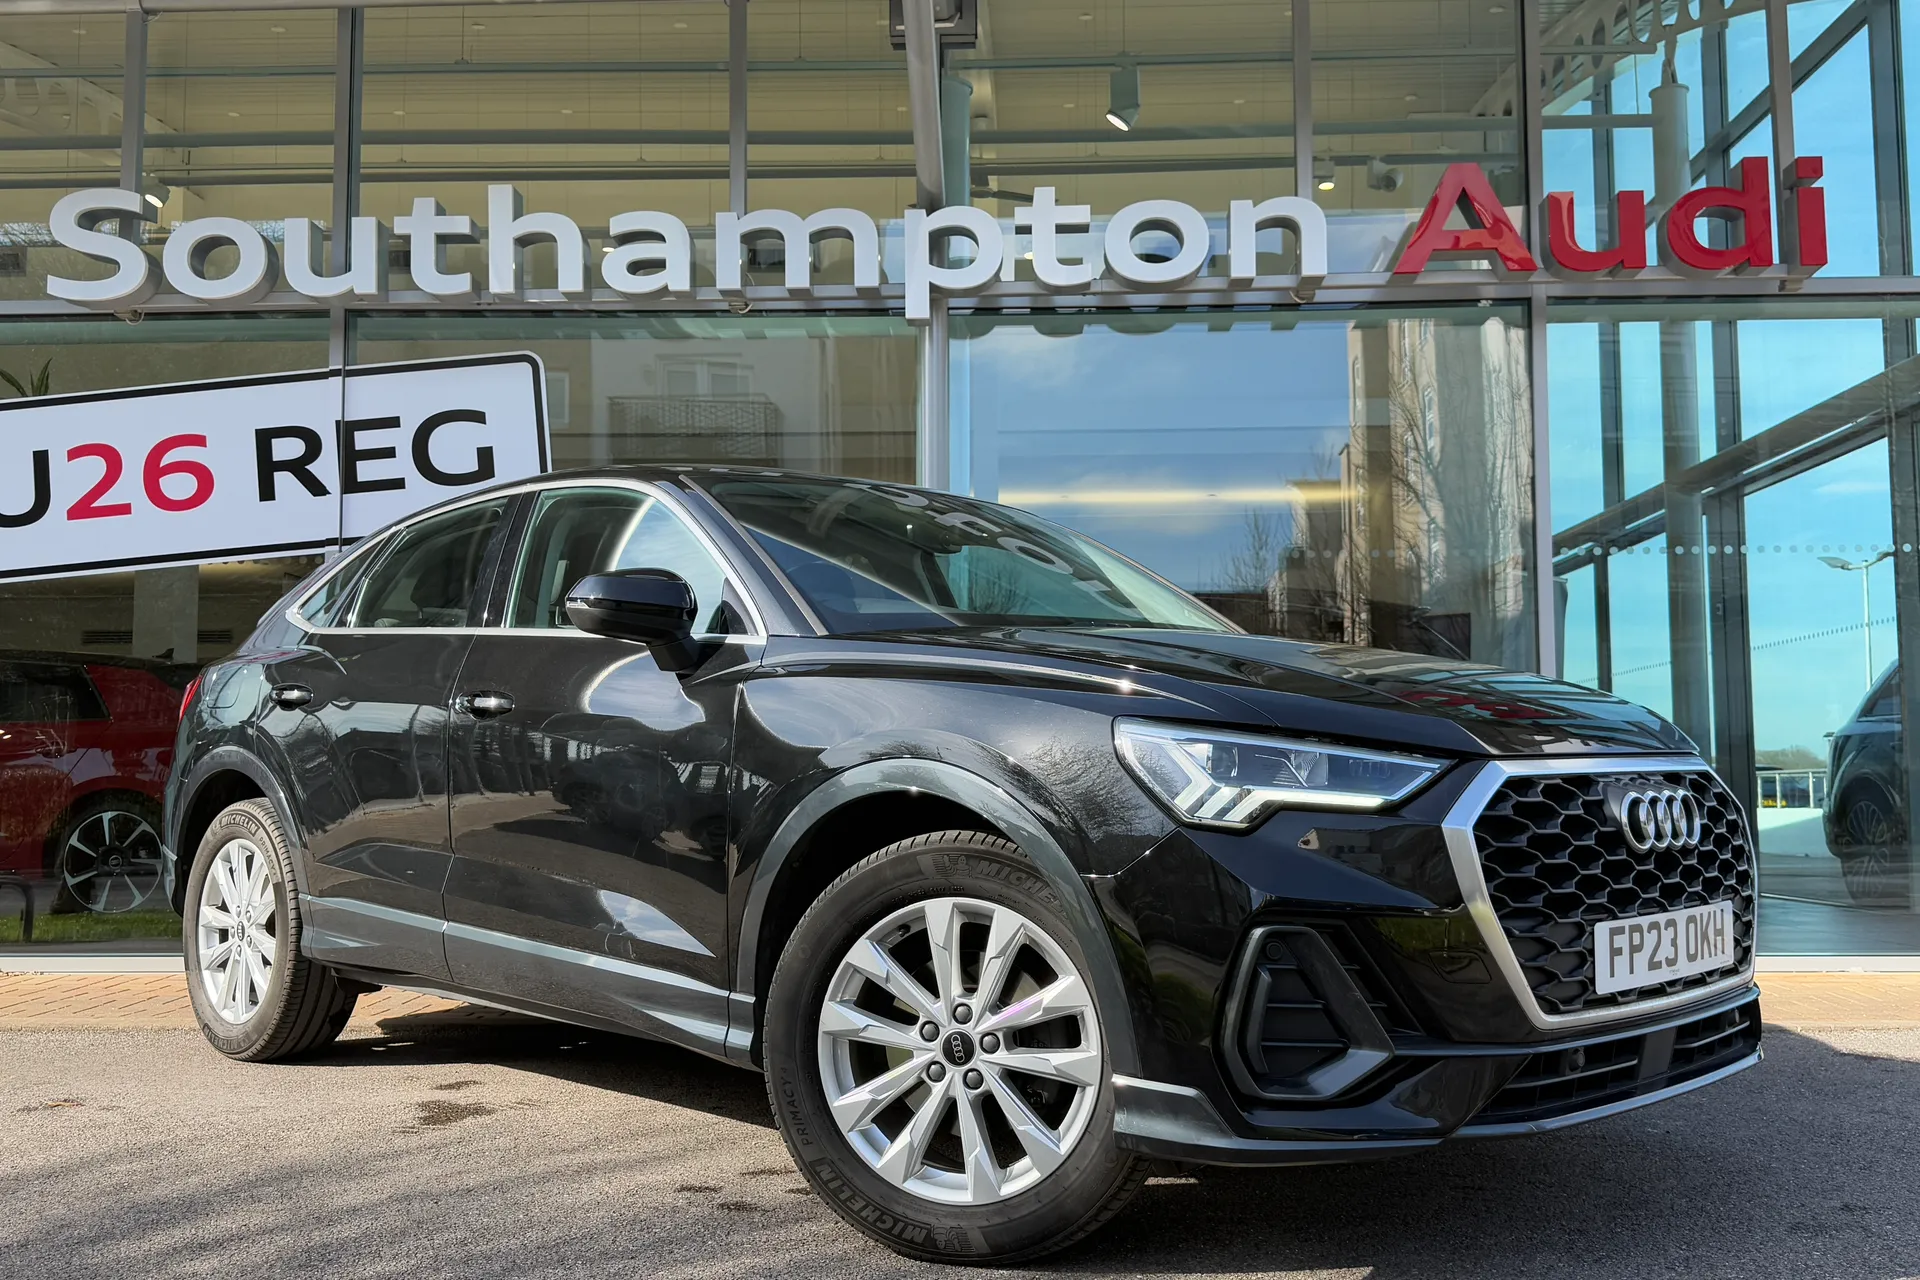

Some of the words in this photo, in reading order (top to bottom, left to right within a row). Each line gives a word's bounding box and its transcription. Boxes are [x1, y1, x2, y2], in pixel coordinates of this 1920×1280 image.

[47, 184, 1328, 321] Southampton
[1393, 156, 1828, 276] Audi
[255, 409, 496, 502] REG
[221, 814, 258, 834] MICHELIN
[1608, 917, 1679, 978] FP23
[1685, 908, 1725, 963] OKH
[780, 1076, 814, 1146] PRIMACY
[815, 1163, 928, 1244] MICHELIN
